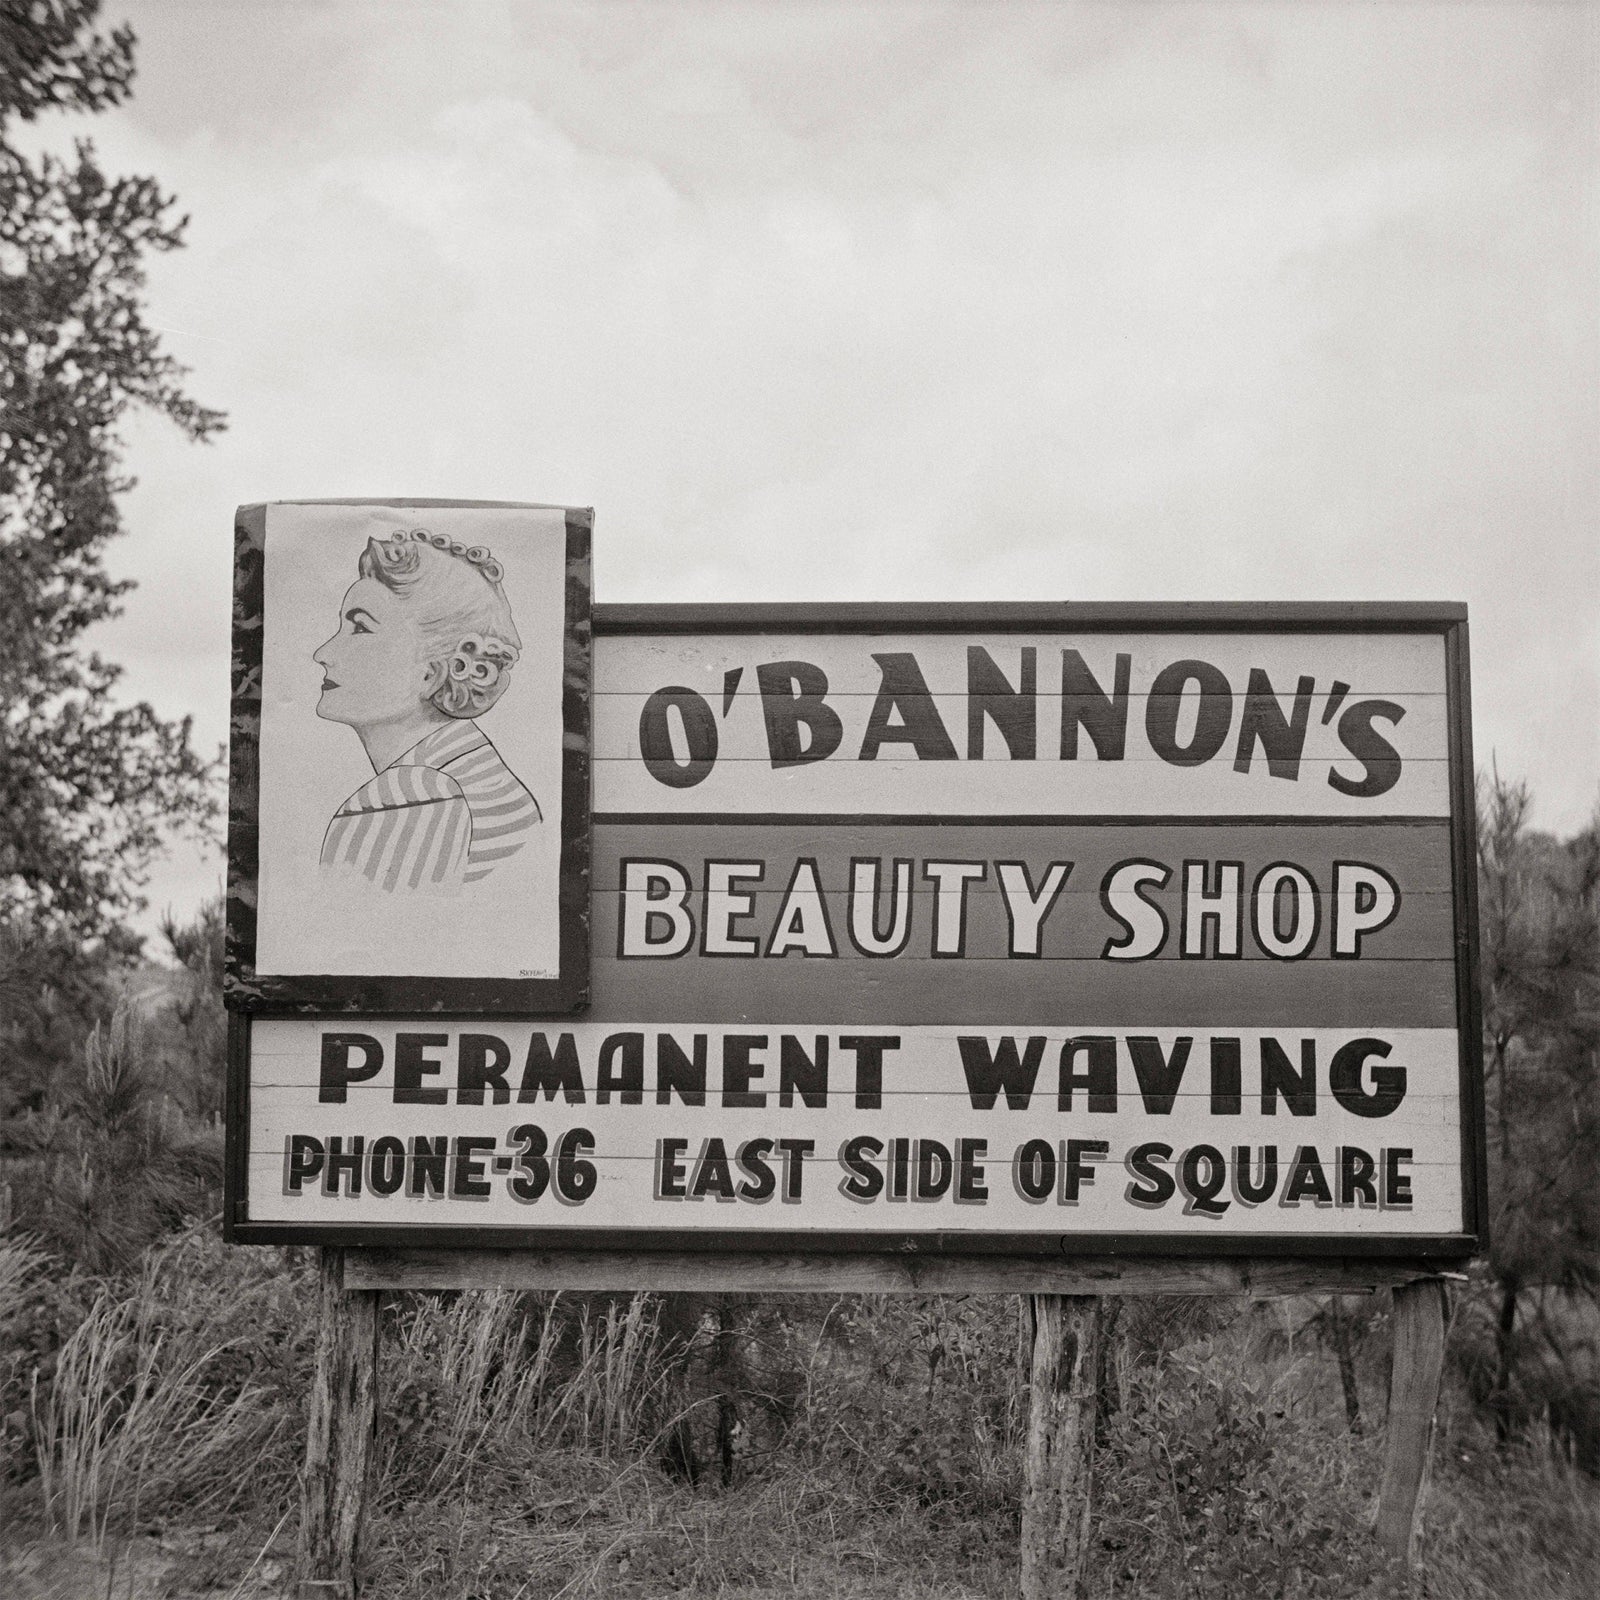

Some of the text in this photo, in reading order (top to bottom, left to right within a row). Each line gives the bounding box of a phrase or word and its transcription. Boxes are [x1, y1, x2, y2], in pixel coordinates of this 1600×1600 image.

[639, 646, 1406, 798] O'BANNON'S
[617, 857, 1401, 961] BEAUTY SHOP
[318, 1032, 1408, 1118] PERMANENT WAVING
[282, 1124, 1413, 1220] PHONE-36 EAST SIDE OF SQUARE
